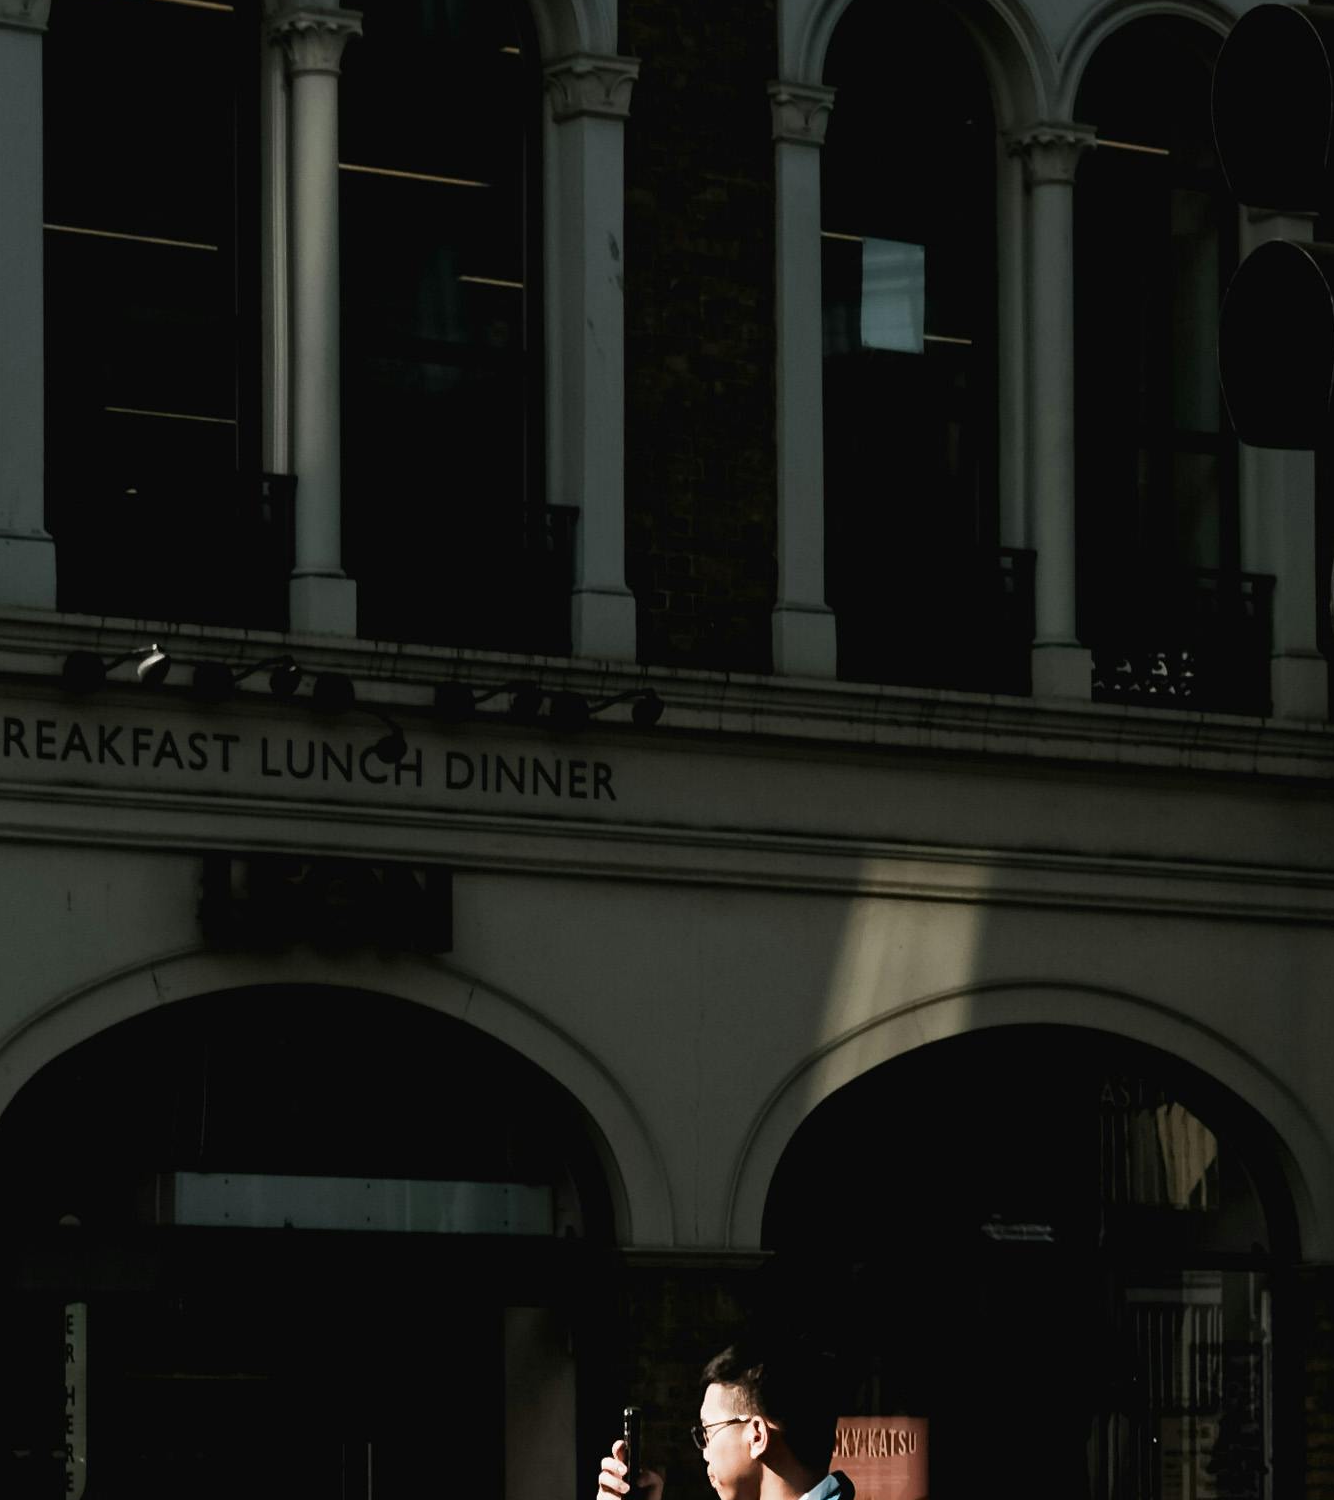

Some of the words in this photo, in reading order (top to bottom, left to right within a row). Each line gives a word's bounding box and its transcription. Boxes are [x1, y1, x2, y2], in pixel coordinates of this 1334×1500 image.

[261, 737, 424, 788] LUNCH
[446, 751, 618, 802] DINNER
[867, 1427, 917, 1459] KATSU
